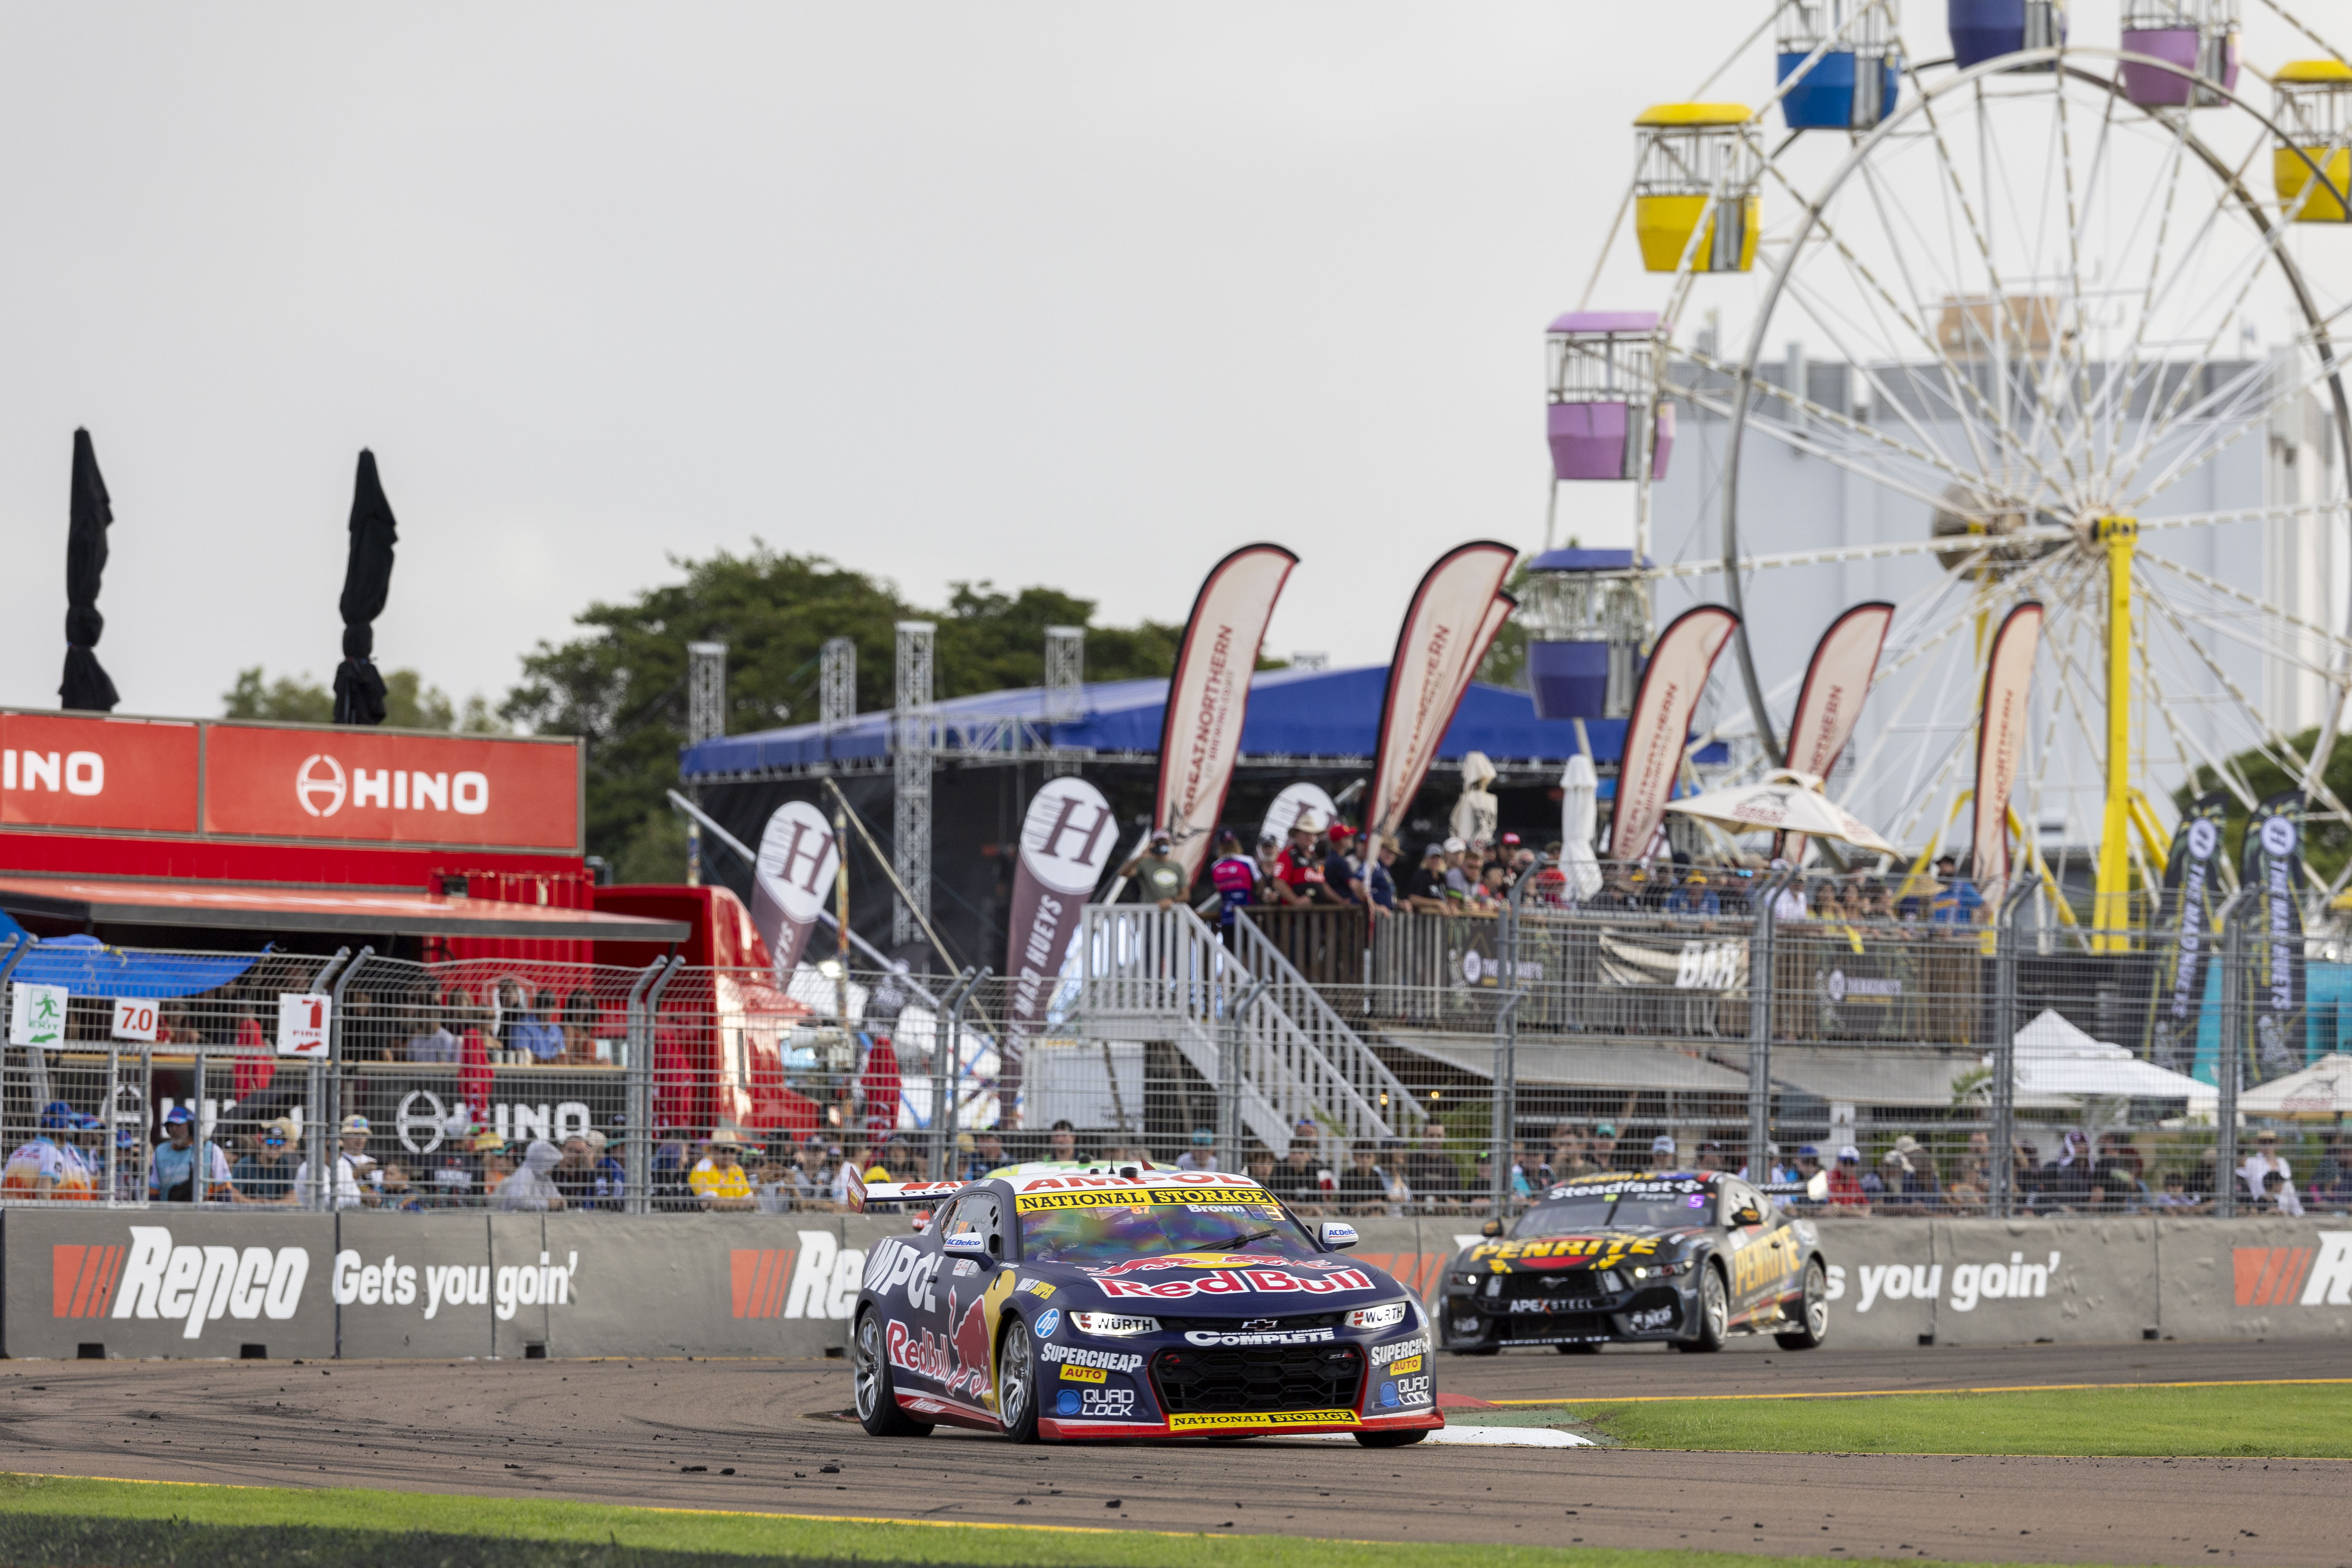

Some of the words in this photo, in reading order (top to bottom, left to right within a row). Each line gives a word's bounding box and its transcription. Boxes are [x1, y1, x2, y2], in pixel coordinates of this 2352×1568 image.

[1196, 625, 1234, 742] NORTHERN
[353, 768, 489, 815] HINO
[1025, 894, 1063, 968] HUEYS
[29, 1020, 60, 1031] EXIT
[121, 1006, 153, 1032] 7.0
[292, 1029, 323, 1037] FIRE
[1022, 1173, 1252, 1192] AMPOL
[1020, 1192, 1145, 1209] NATIONAL
[1154, 1190, 1269, 1203] STORAGE
[1185, 1204, 1246, 1213] Brown
[1130, 1205, 1151, 1214] 87
[1470, 1238, 1662, 1262] PENRITE
[112, 1226, 309, 1338] Repco
[332, 1249, 417, 1305] Gets
[424, 1265, 490, 1320] you
[495, 1250, 578, 1320] goin'
[864, 1239, 944, 1313] AMPOL
[1091, 1270, 1250, 1298] Red
[1240, 1269, 1375, 1294] Bull
[1856, 1264, 1943, 1312] you
[1950, 1251, 2061, 1312] goin'
[1030, 1281, 1056, 1299] SUPER
[1038, 1313, 1058, 1335] hp
[1184, 1330, 1335, 1346] COMPLETE
[886, 1319, 926, 1374] Red
[925, 1330, 951, 1381] Bull
[1041, 1343, 1143, 1373] SUPERCHEAP
[1372, 1333, 1430, 1366] SUPERCH
[1065, 1368, 1102, 1379] AUTO
[1394, 1359, 1418, 1372] AUTO
[1398, 1376, 1429, 1393] QUAD
[1083, 1389, 1134, 1403] QUAD
[1399, 1390, 1431, 1405] LOCK
[1082, 1404, 1134, 1416] LOCK
[1174, 1415, 1266, 1426] NATIONAL
[1275, 1411, 1352, 1421] STORAGE
